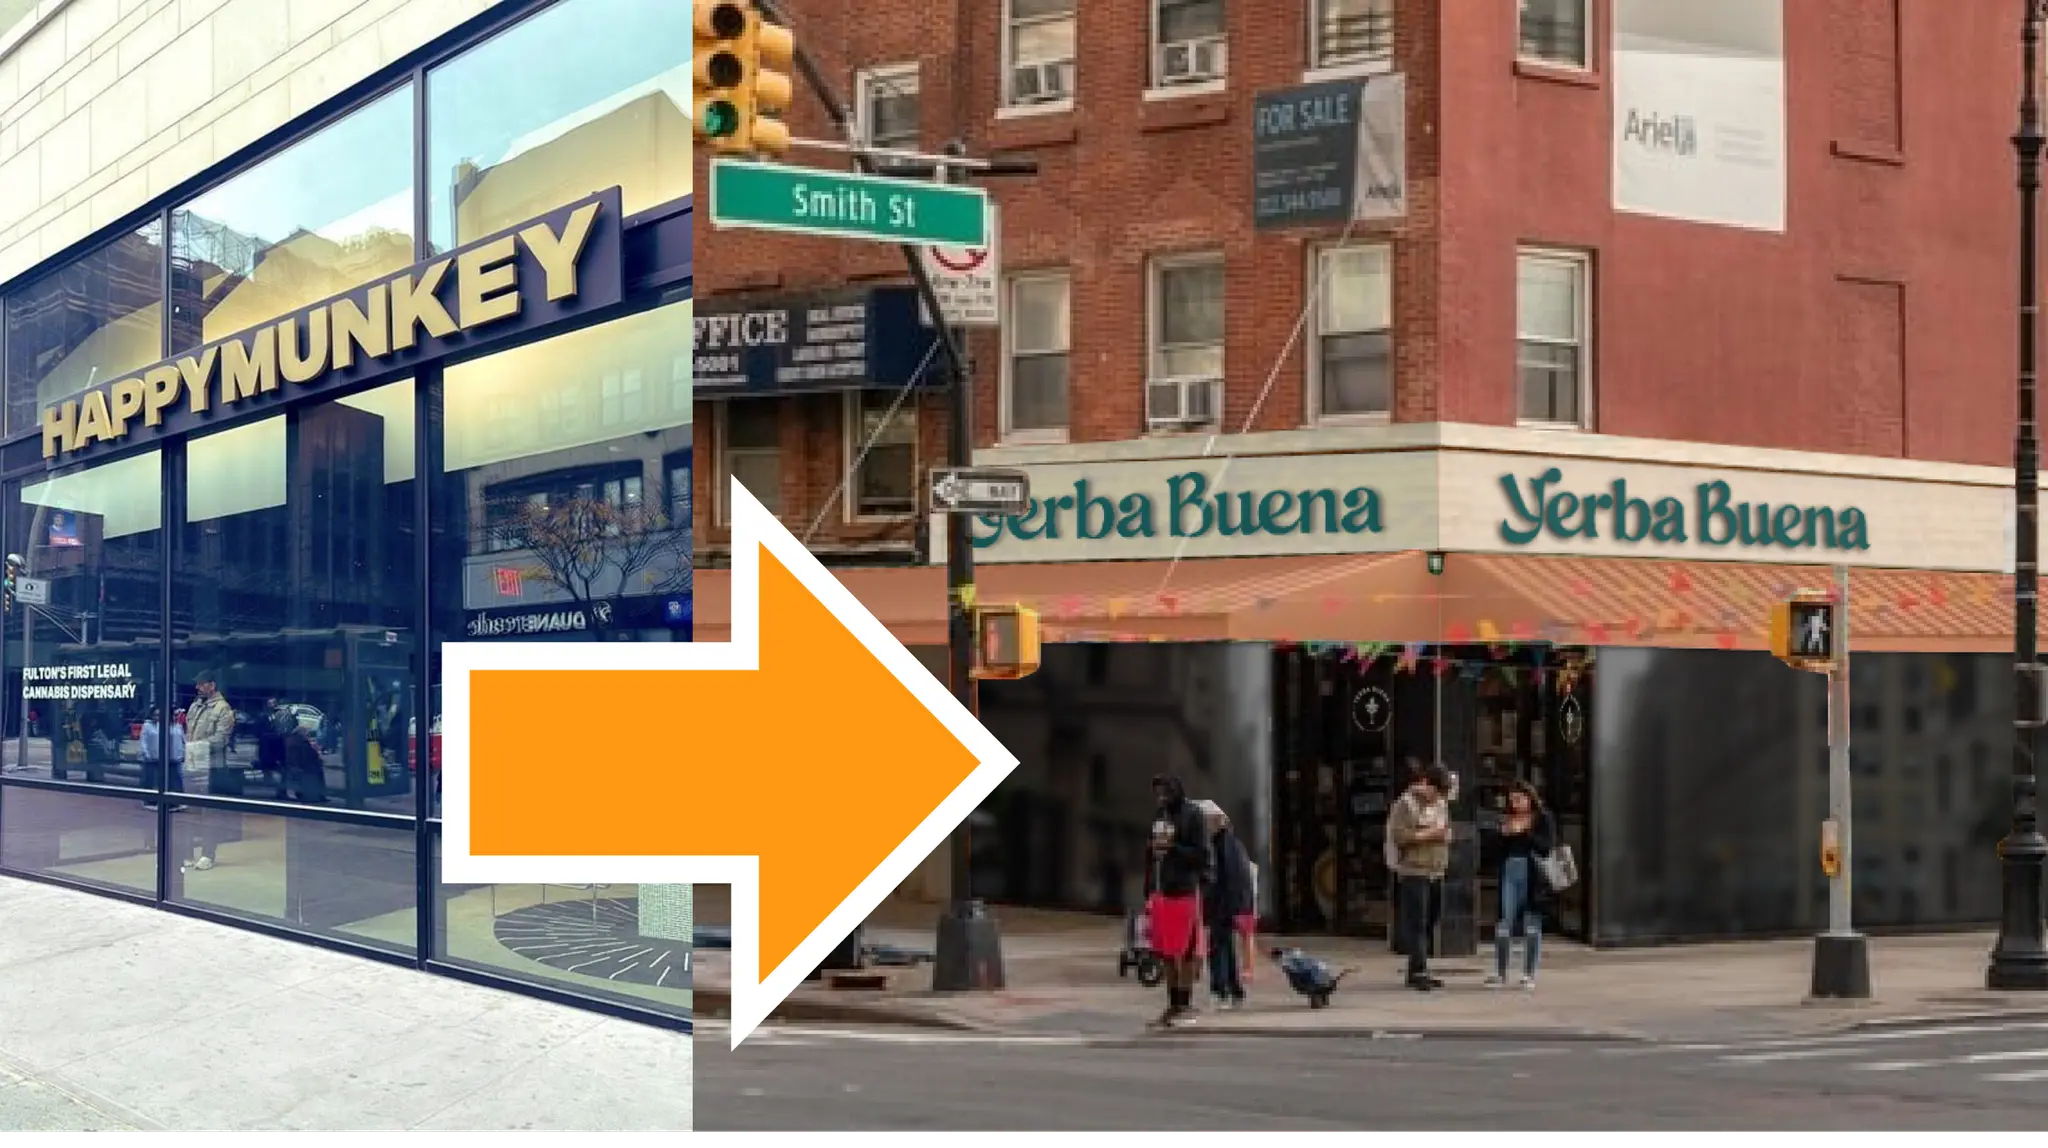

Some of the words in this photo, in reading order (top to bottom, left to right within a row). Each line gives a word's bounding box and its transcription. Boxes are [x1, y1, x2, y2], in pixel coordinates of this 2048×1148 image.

[1259, 104, 1295, 136] FOR
[1300, 93, 1349, 131] SALE
[792, 183, 876, 224] Smith
[888, 195, 915, 227] St
[42, 200, 604, 459] HAPPYMUNKEY
[1166, 471, 1385, 535] Buena
[1499, 467, 1688, 545] Yerba
[1698, 479, 1870, 551] Buena
[22, 666, 67, 680] FULTON'S
[67, 665, 96, 679] FIRST
[97, 663, 132, 678] LEGAL
[22, 685, 70, 699] CANNABIS
[71, 684, 137, 699] DISPENSARY
